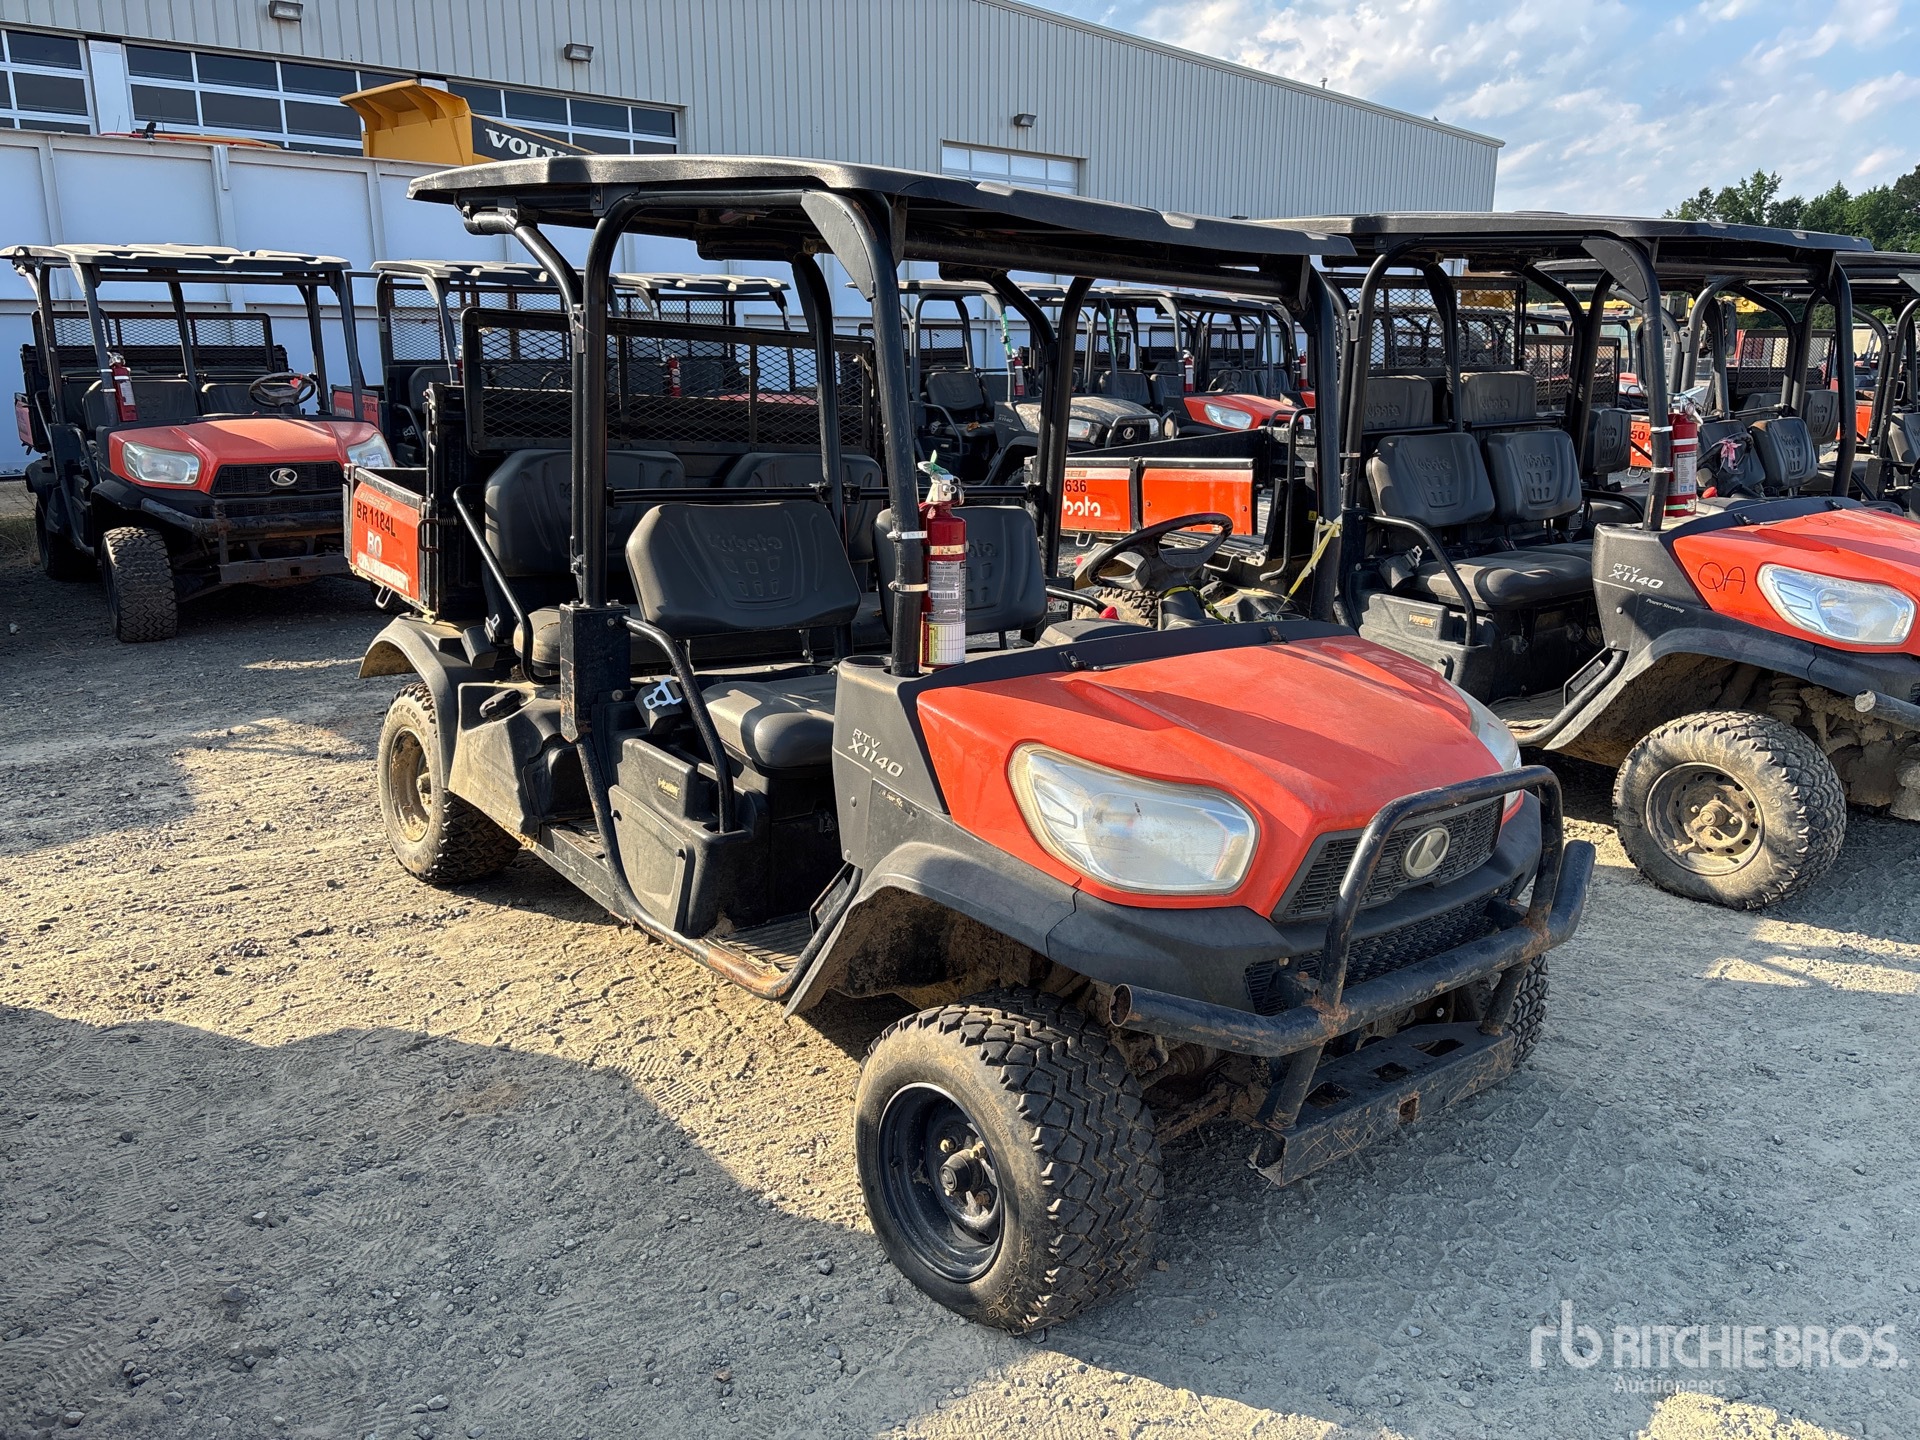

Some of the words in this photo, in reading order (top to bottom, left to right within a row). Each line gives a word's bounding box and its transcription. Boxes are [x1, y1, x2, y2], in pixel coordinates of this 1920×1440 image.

[485, 128, 571, 158] VOLV
[1063, 495, 1101, 517] bota
[1608, 570, 1664, 588] X1140
[1613, 563, 1641, 573] RTV
[1698, 562, 1746, 594] QA
[853, 728, 880, 748] RTV
[847, 738, 904, 777] X1140
